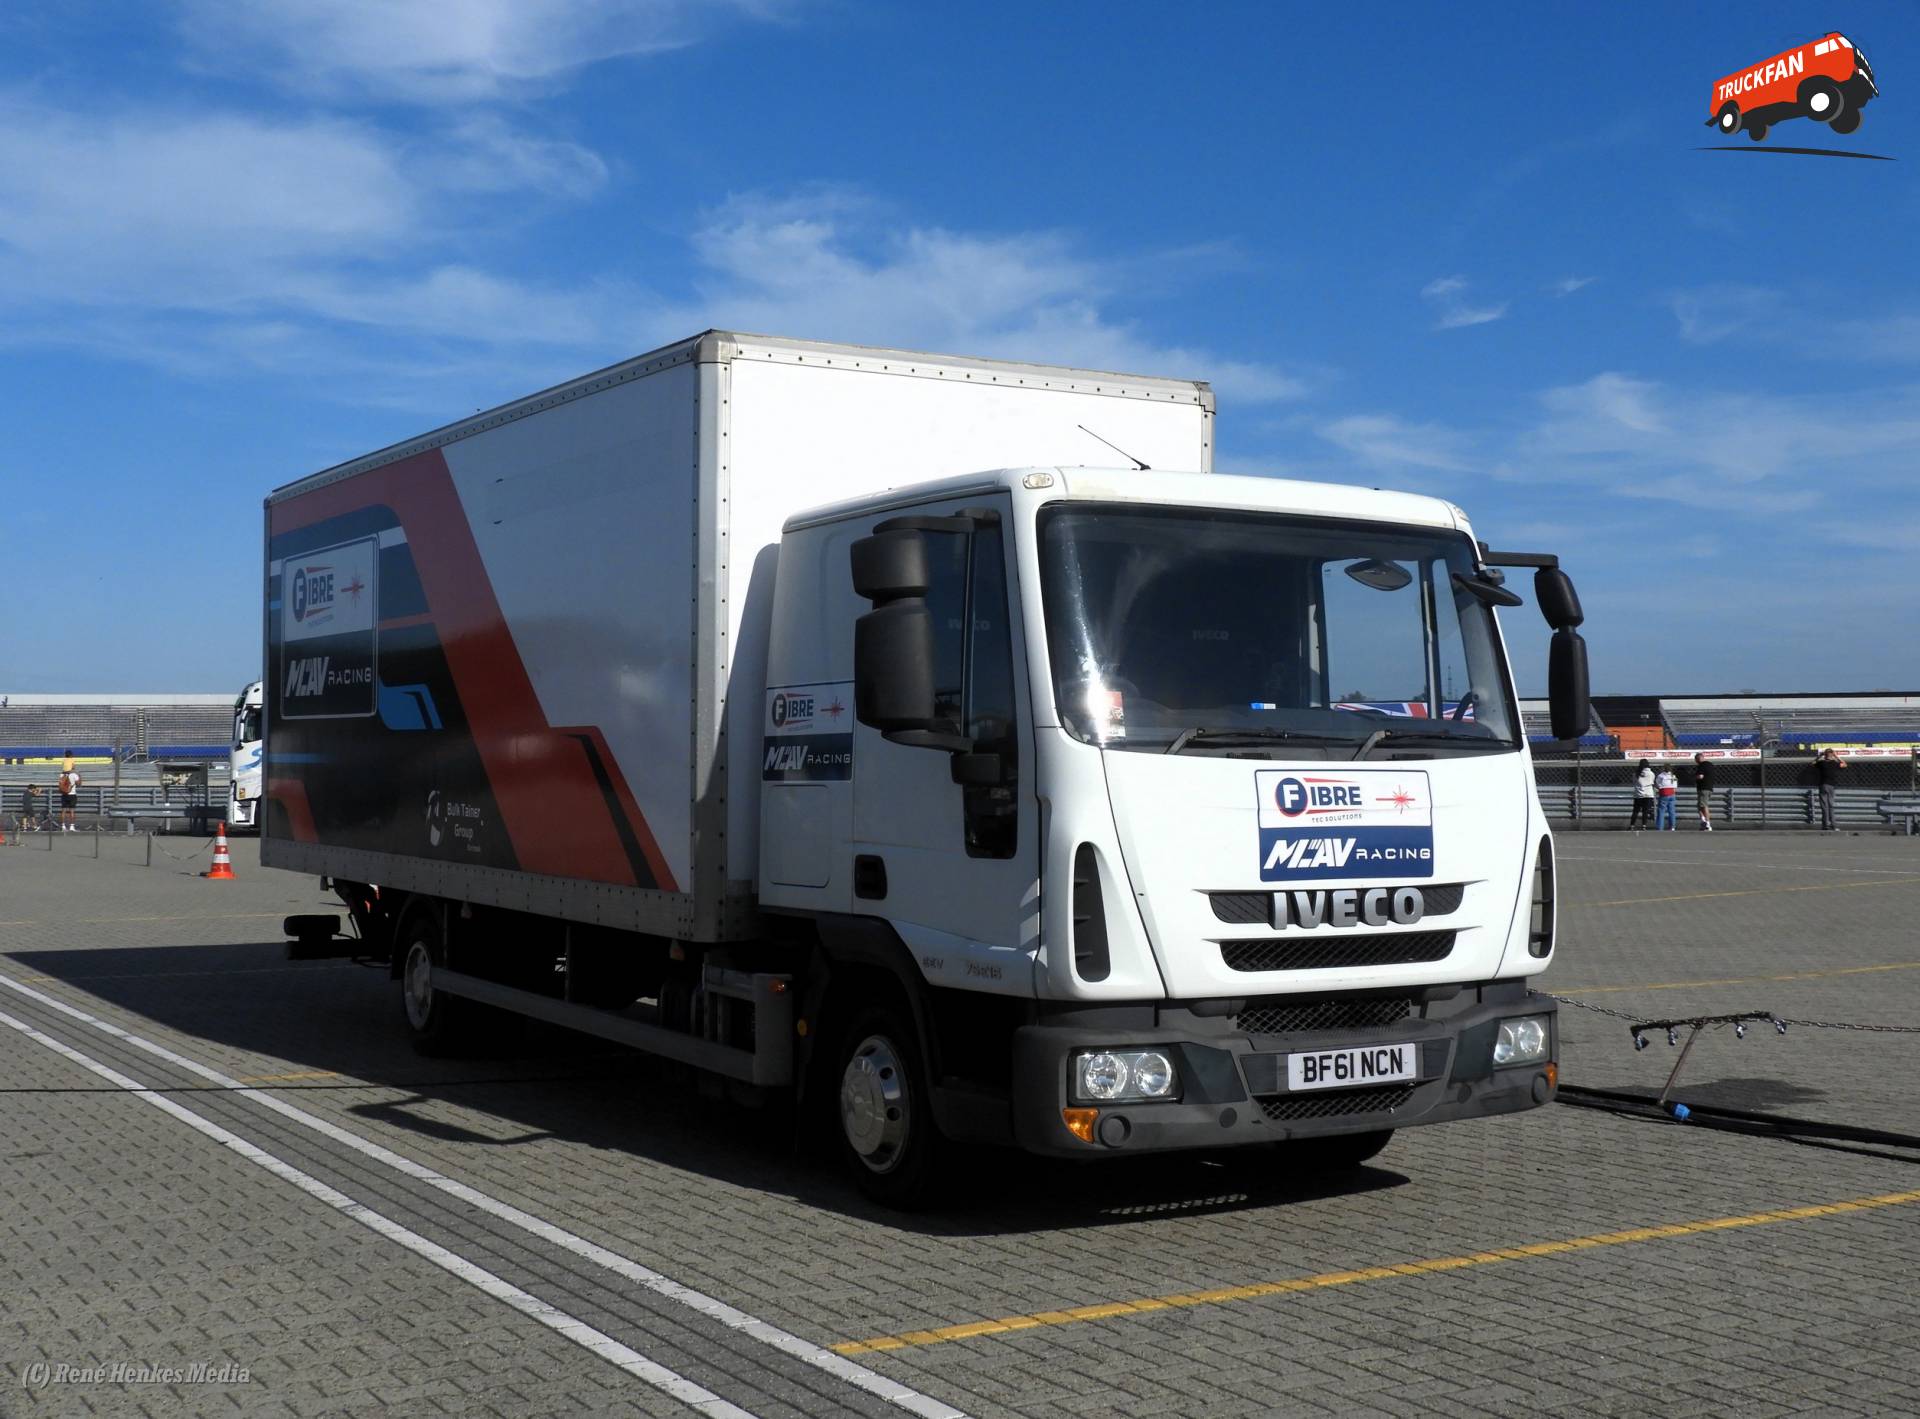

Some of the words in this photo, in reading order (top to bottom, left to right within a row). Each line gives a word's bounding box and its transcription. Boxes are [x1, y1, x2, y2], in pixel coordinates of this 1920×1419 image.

[295, 573, 334, 610] FIBRE
[328, 667, 372, 685] RACING
[776, 698, 815, 721] FIBRE
[807, 753, 851, 765] RACING
[1282, 782, 1363, 810] FIBRE
[1311, 816, 1324, 824] TEC
[1325, 813, 1362, 823] SOLUTIONS
[1355, 847, 1431, 861] RACING
[1271, 886, 1425, 931] IVECO
[1302, 1052, 1355, 1083] BF61
[1361, 1047, 1403, 1078] NCN
